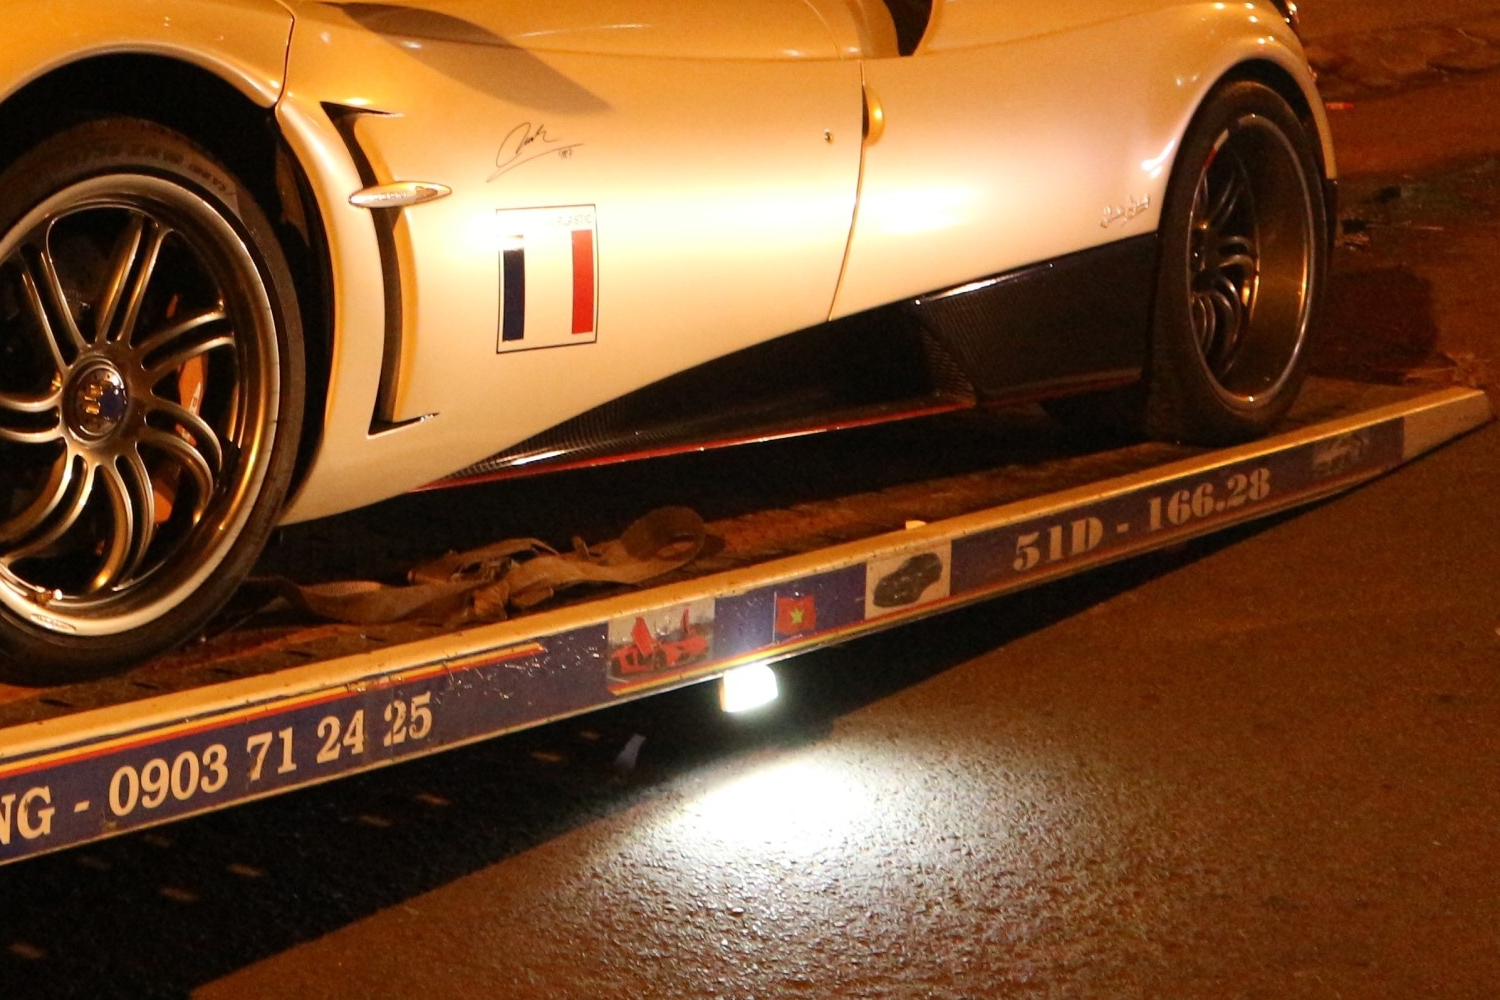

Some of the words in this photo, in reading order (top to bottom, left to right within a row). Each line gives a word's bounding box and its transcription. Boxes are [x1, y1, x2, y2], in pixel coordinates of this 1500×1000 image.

[1013, 516, 1104, 572] 51D
[1150, 467, 1271, 532] 166.28
[109, 743, 229, 817] 0903
[246, 726, 297, 783] 71
[316, 709, 366, 764] 24
[383, 691, 432, 747] 25
